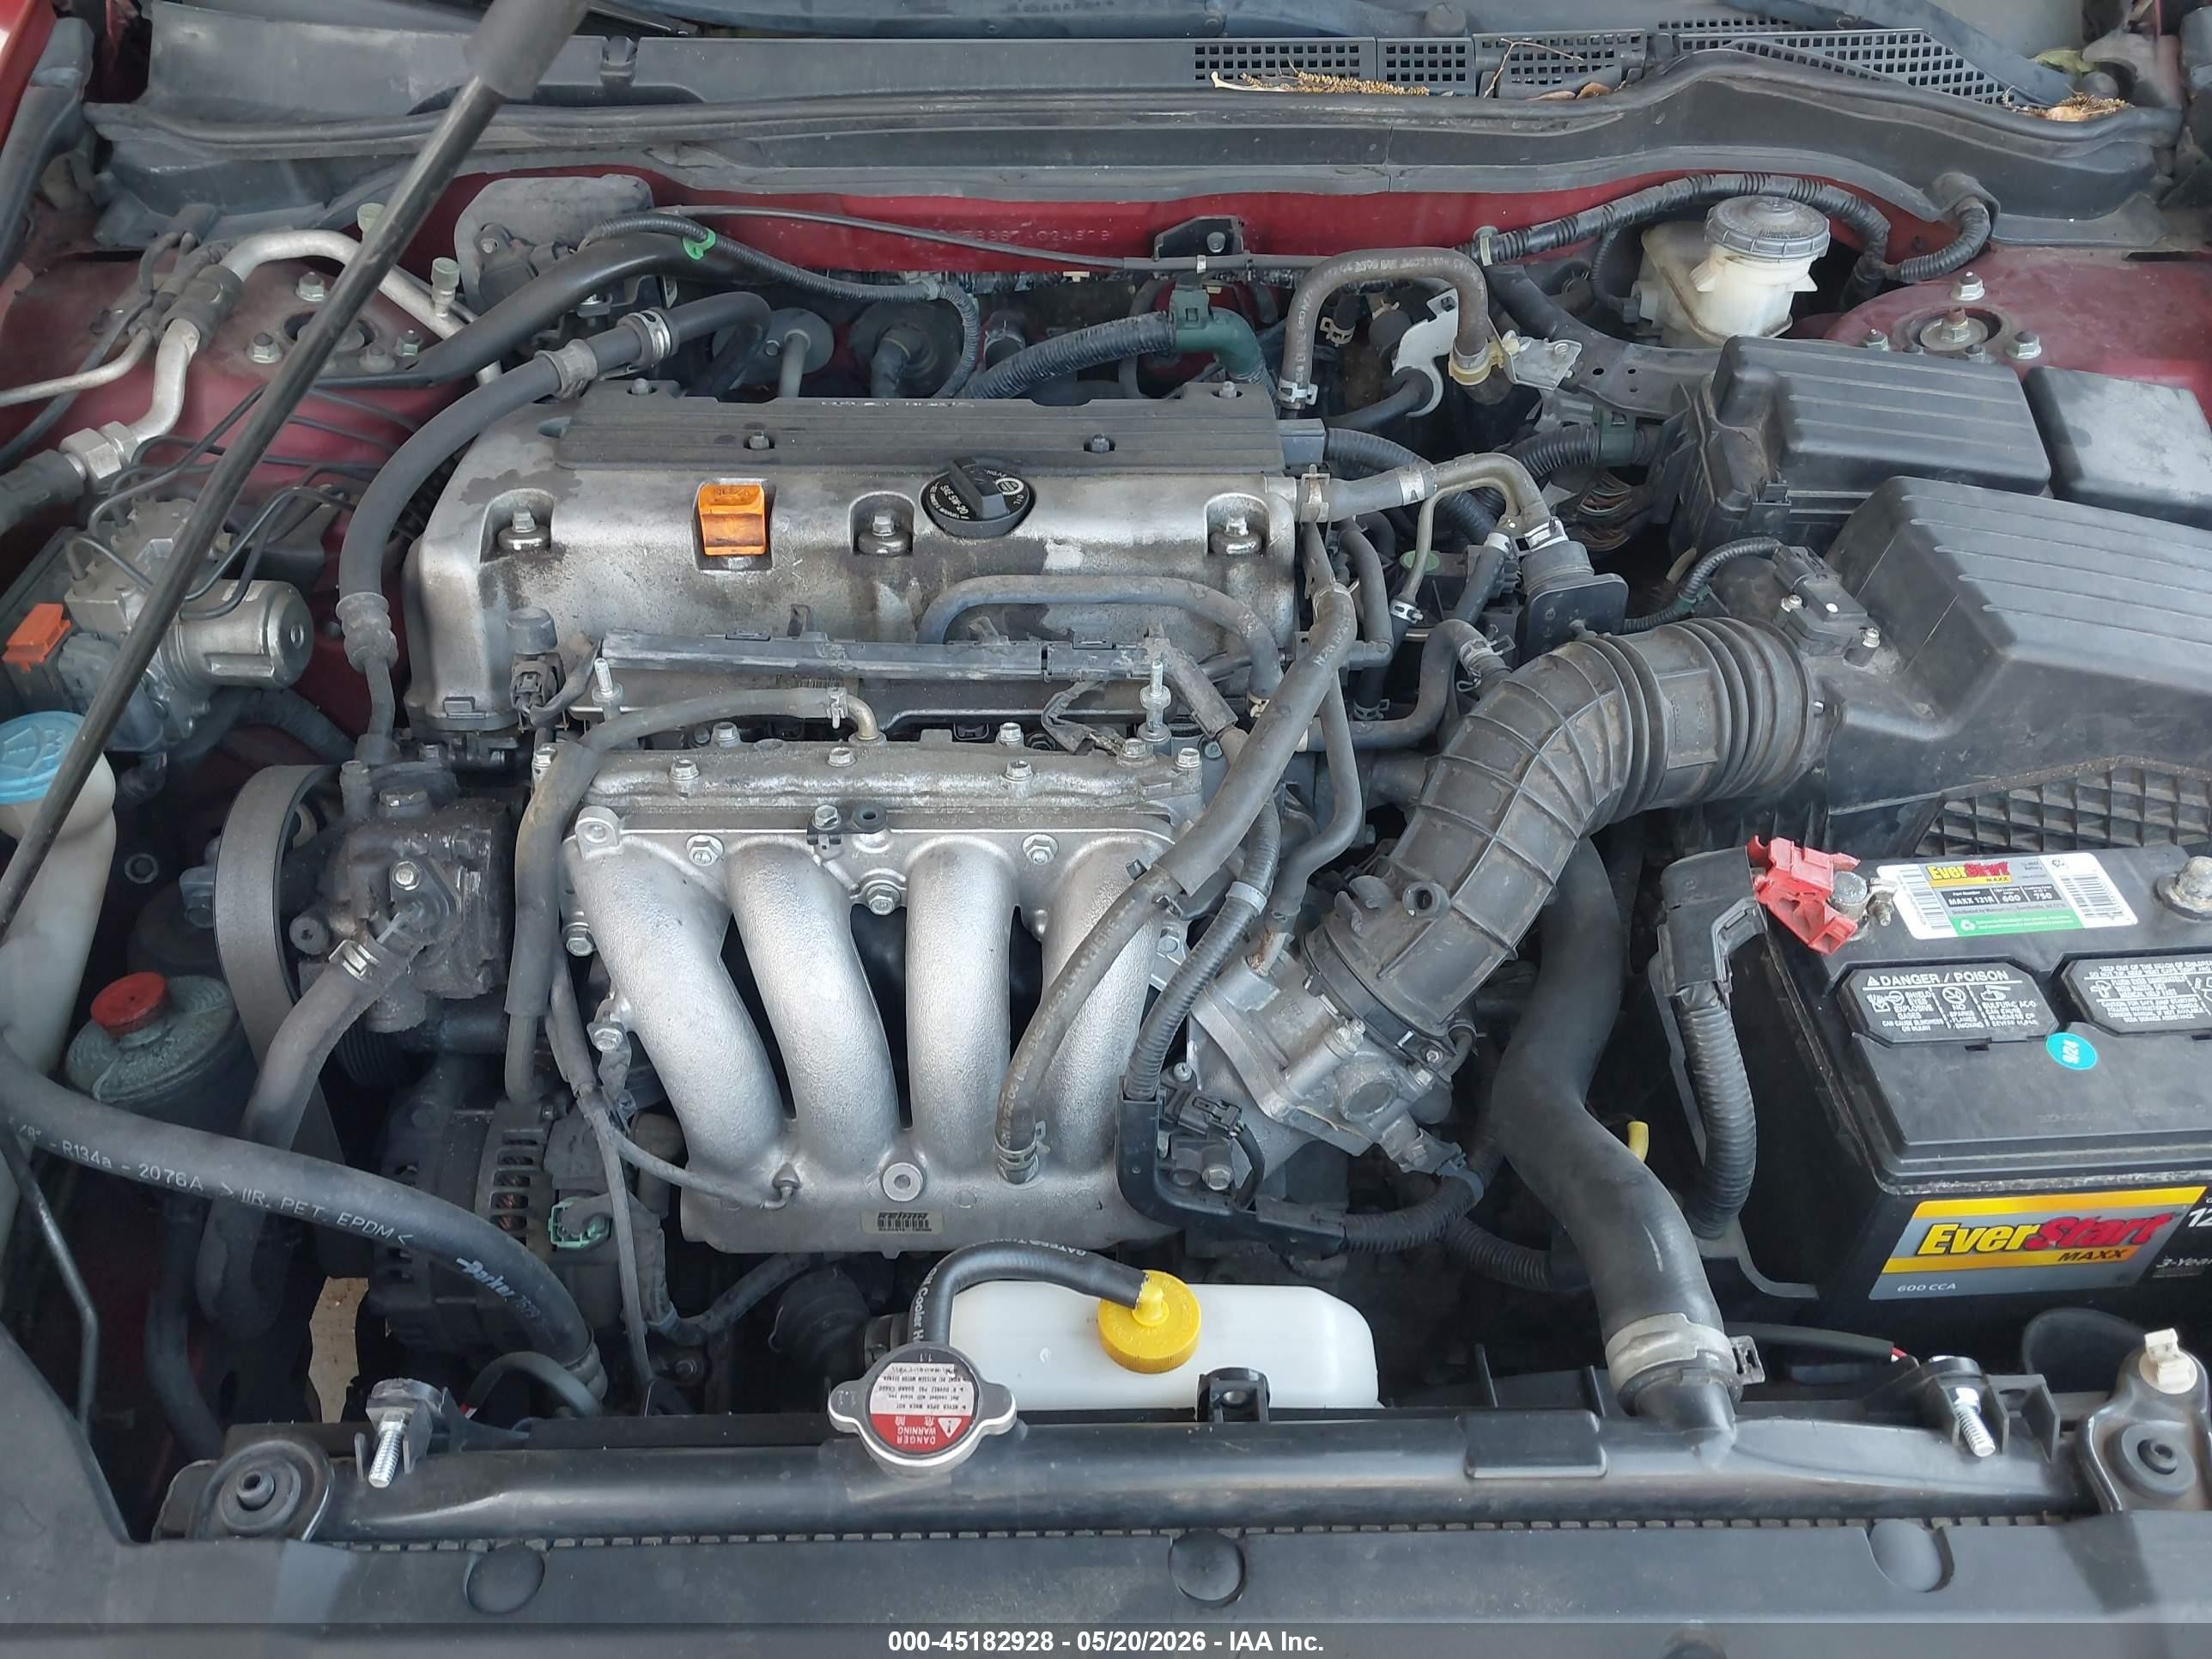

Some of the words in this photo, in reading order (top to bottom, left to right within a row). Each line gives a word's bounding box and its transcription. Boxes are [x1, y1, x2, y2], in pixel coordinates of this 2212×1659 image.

[1948, 897, 1973, 906] MAXX
[1880, 975, 1940, 987] DANGER
[1944, 973, 1950, 983] /
[1952, 970, 2009, 982] POISON
[63, 1140, 112, 1169] R134a
[138, 1163, 204, 1191] 2076A
[1916, 1212, 2175, 1255] EverStart
[2057, 1249, 2125, 1262] MAXX
[1896, 1283, 1927, 1292] 600
[1929, 1282, 1957, 1291] CCA
[913, 1288, 928, 1326] Cooler
[897, 1426, 936, 1436] WARNING
[896, 1436, 936, 1444] DANGER
